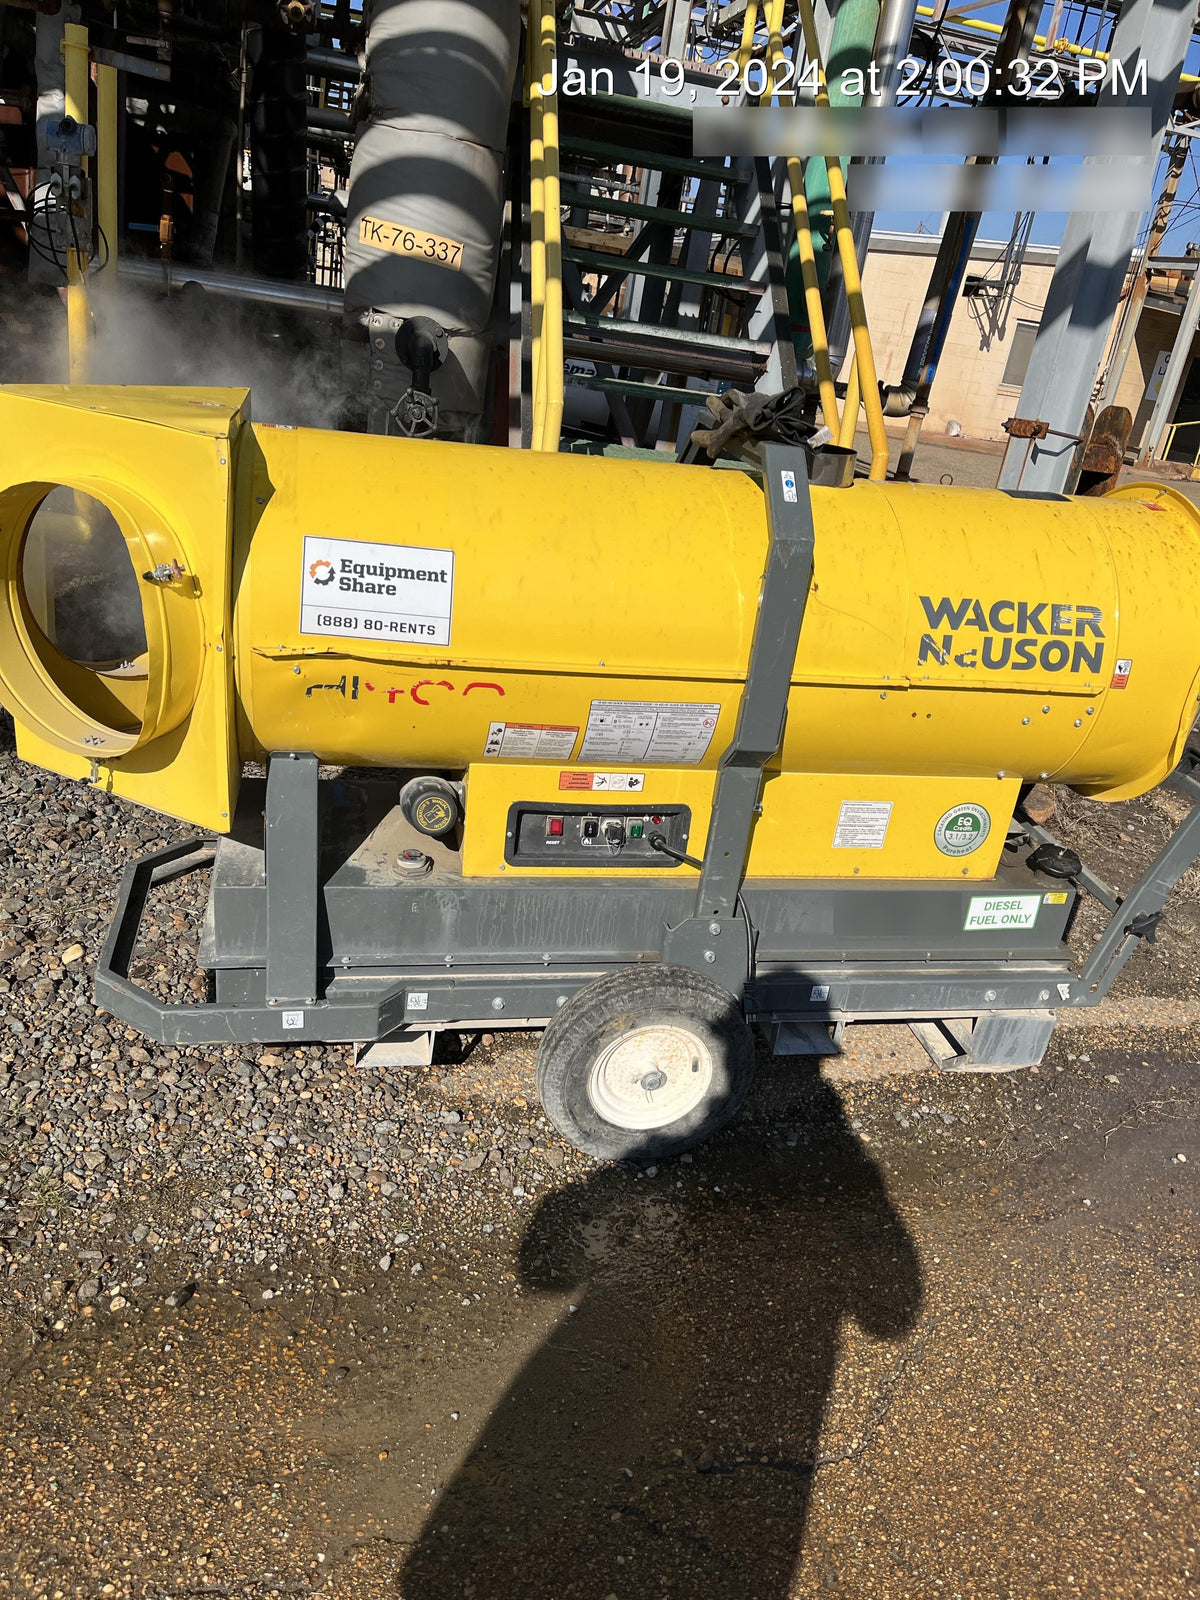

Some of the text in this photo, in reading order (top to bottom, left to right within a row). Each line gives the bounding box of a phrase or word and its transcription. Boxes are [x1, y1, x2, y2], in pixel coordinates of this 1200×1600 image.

[362, 219, 461, 264] TK-76-337
[340, 558, 448, 583] Equipment
[339, 576, 397, 596] Share
[317, 614, 436, 636] (888) 80-RENTS
[919, 595, 1106, 638] WACKER
[957, 816, 973, 826] EQ
[948, 833, 973, 841] 3.1/3.2
[984, 900, 1023, 911] DIESEL
[969, 914, 1032, 925] FUEL ONLY
